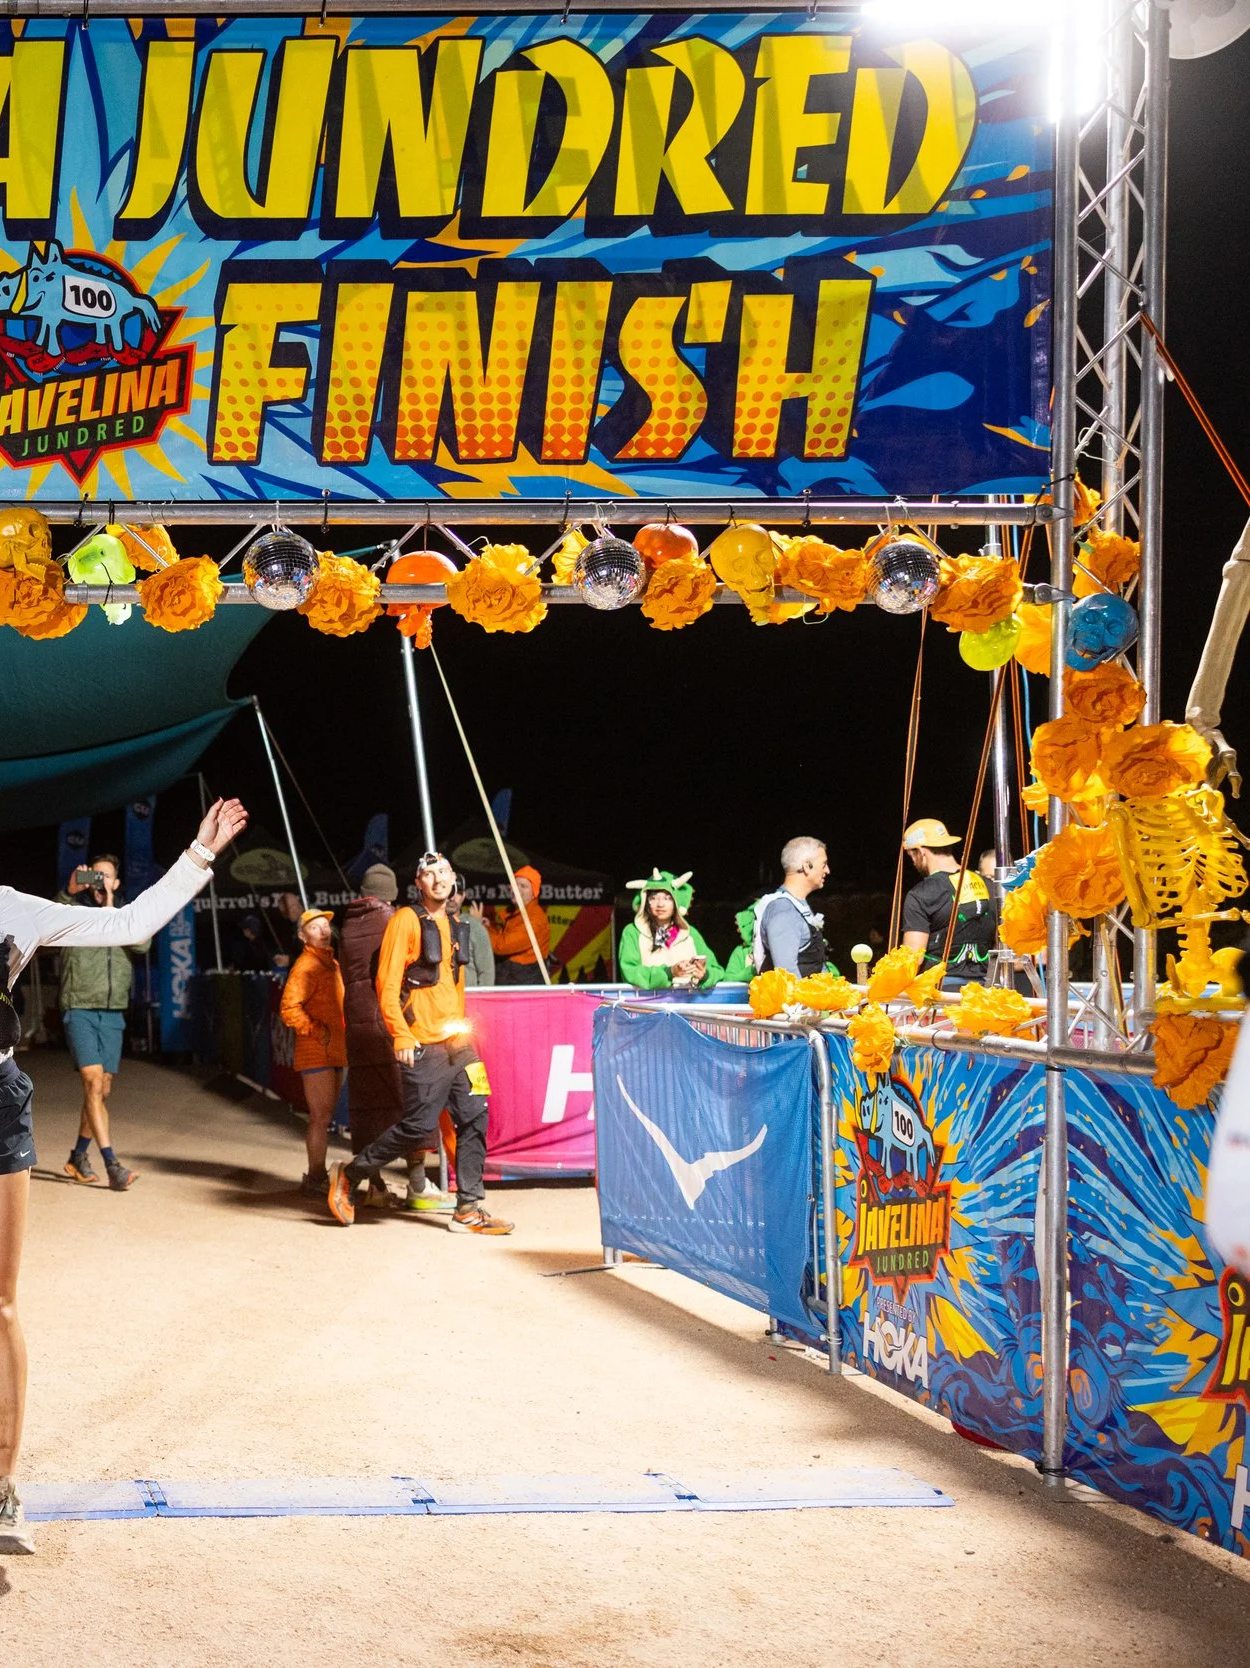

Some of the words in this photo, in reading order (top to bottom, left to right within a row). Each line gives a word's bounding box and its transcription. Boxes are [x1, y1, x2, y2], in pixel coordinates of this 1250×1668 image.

[120, 34, 980, 221] JUNDRED
[70, 284, 113, 312] 100
[211, 278, 875, 463] FINISH
[22, 415, 145, 456] JUNDRED
[541, 883, 603, 900] Butter
[894, 1110, 914, 1140] 100
[857, 1192, 945, 1256] JAVELINA
[876, 1250, 930, 1273] JUNDRED
[862, 1310, 929, 1388] HOKA
